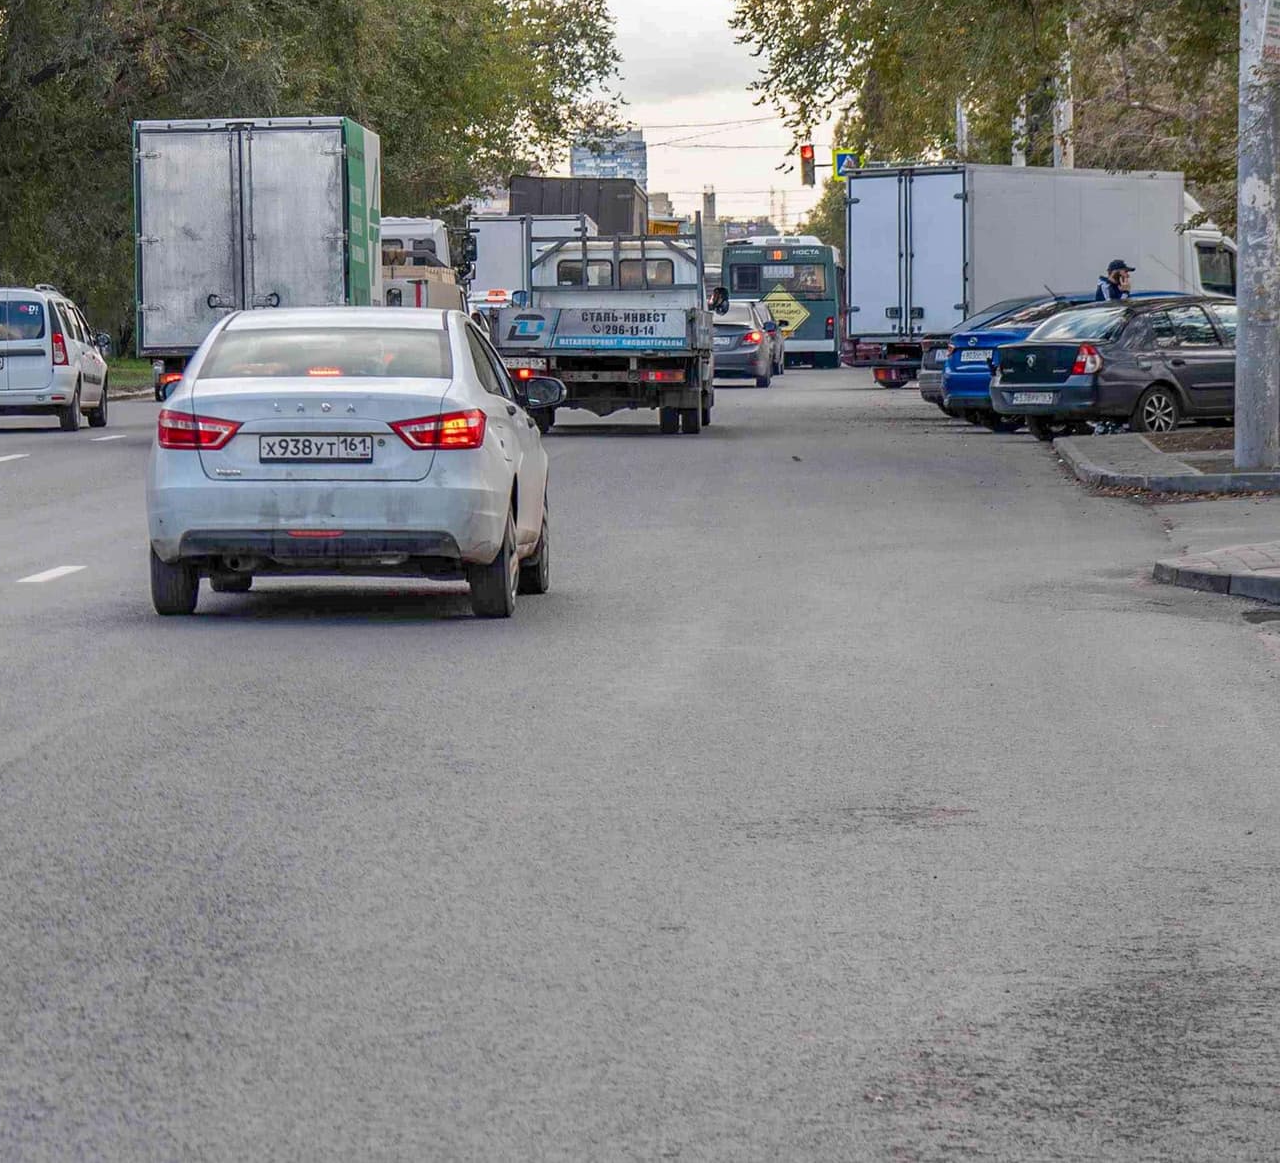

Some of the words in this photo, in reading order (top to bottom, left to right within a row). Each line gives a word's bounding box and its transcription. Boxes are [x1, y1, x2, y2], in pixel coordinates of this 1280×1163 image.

[581, 311, 667, 323] СТАЛЬ-ИНВЕСТ
[605, 324, 654, 336] 296-11-14
[266, 439, 336, 456] Х938УТ
[340, 437, 368, 452] 161
